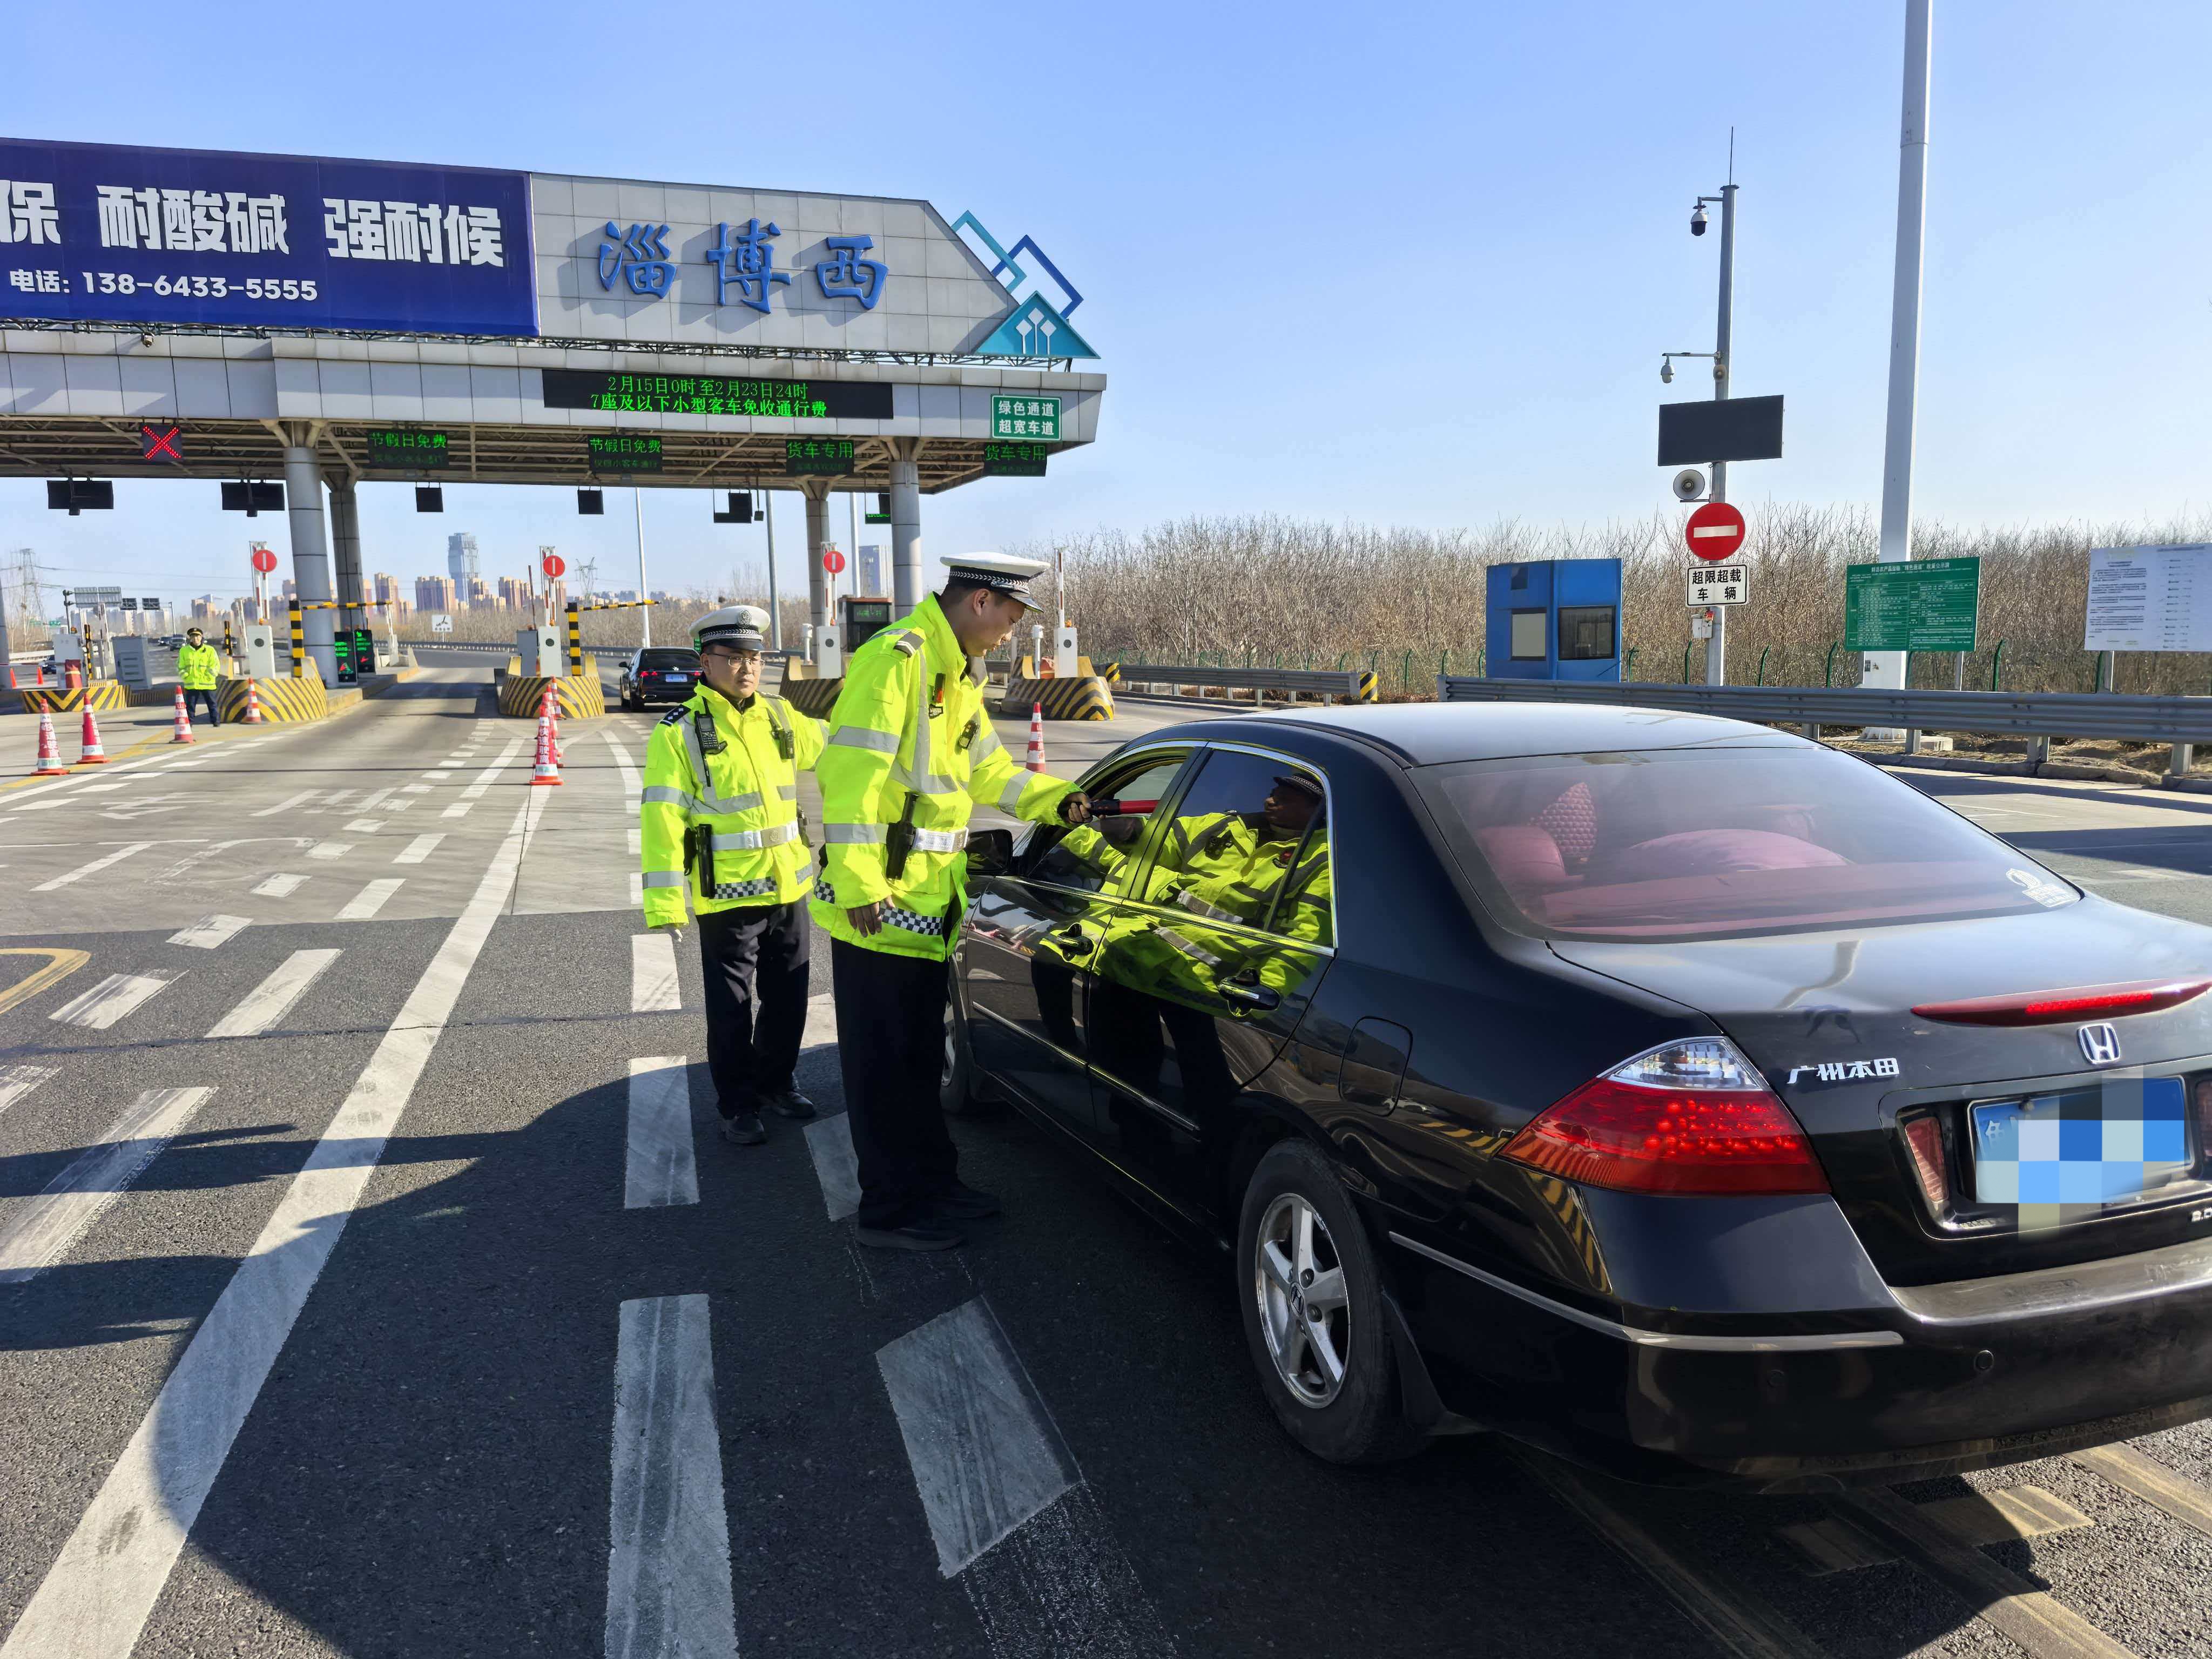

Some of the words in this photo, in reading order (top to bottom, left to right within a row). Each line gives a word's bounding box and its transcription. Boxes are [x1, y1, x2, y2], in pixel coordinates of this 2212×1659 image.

[97, 185, 290, 255] 耐酸碱
[323, 198, 504, 268] 强耐候
[599, 218, 890, 314] 淄博西
[83, 271, 318, 301] 138-6433-5555
[608, 375, 808, 401] 2月15日0时至2月23日24时
[591, 394, 827, 418] 7座及以下小型客车免收通行费
[999, 400, 1055, 416] 绿色通道
[999, 419, 1055, 435] 超宽车道
[369, 431, 447, 448] 节假日免费
[590, 437, 661, 454] 节假日免费
[787, 441, 853, 458] 货车专用
[985, 444, 1046, 461] 货车专用
[1692, 568, 1742, 585] 超限超载
[1697, 586, 1737, 602] 车辆
[1786, 1057, 1899, 1084] 广州本田
